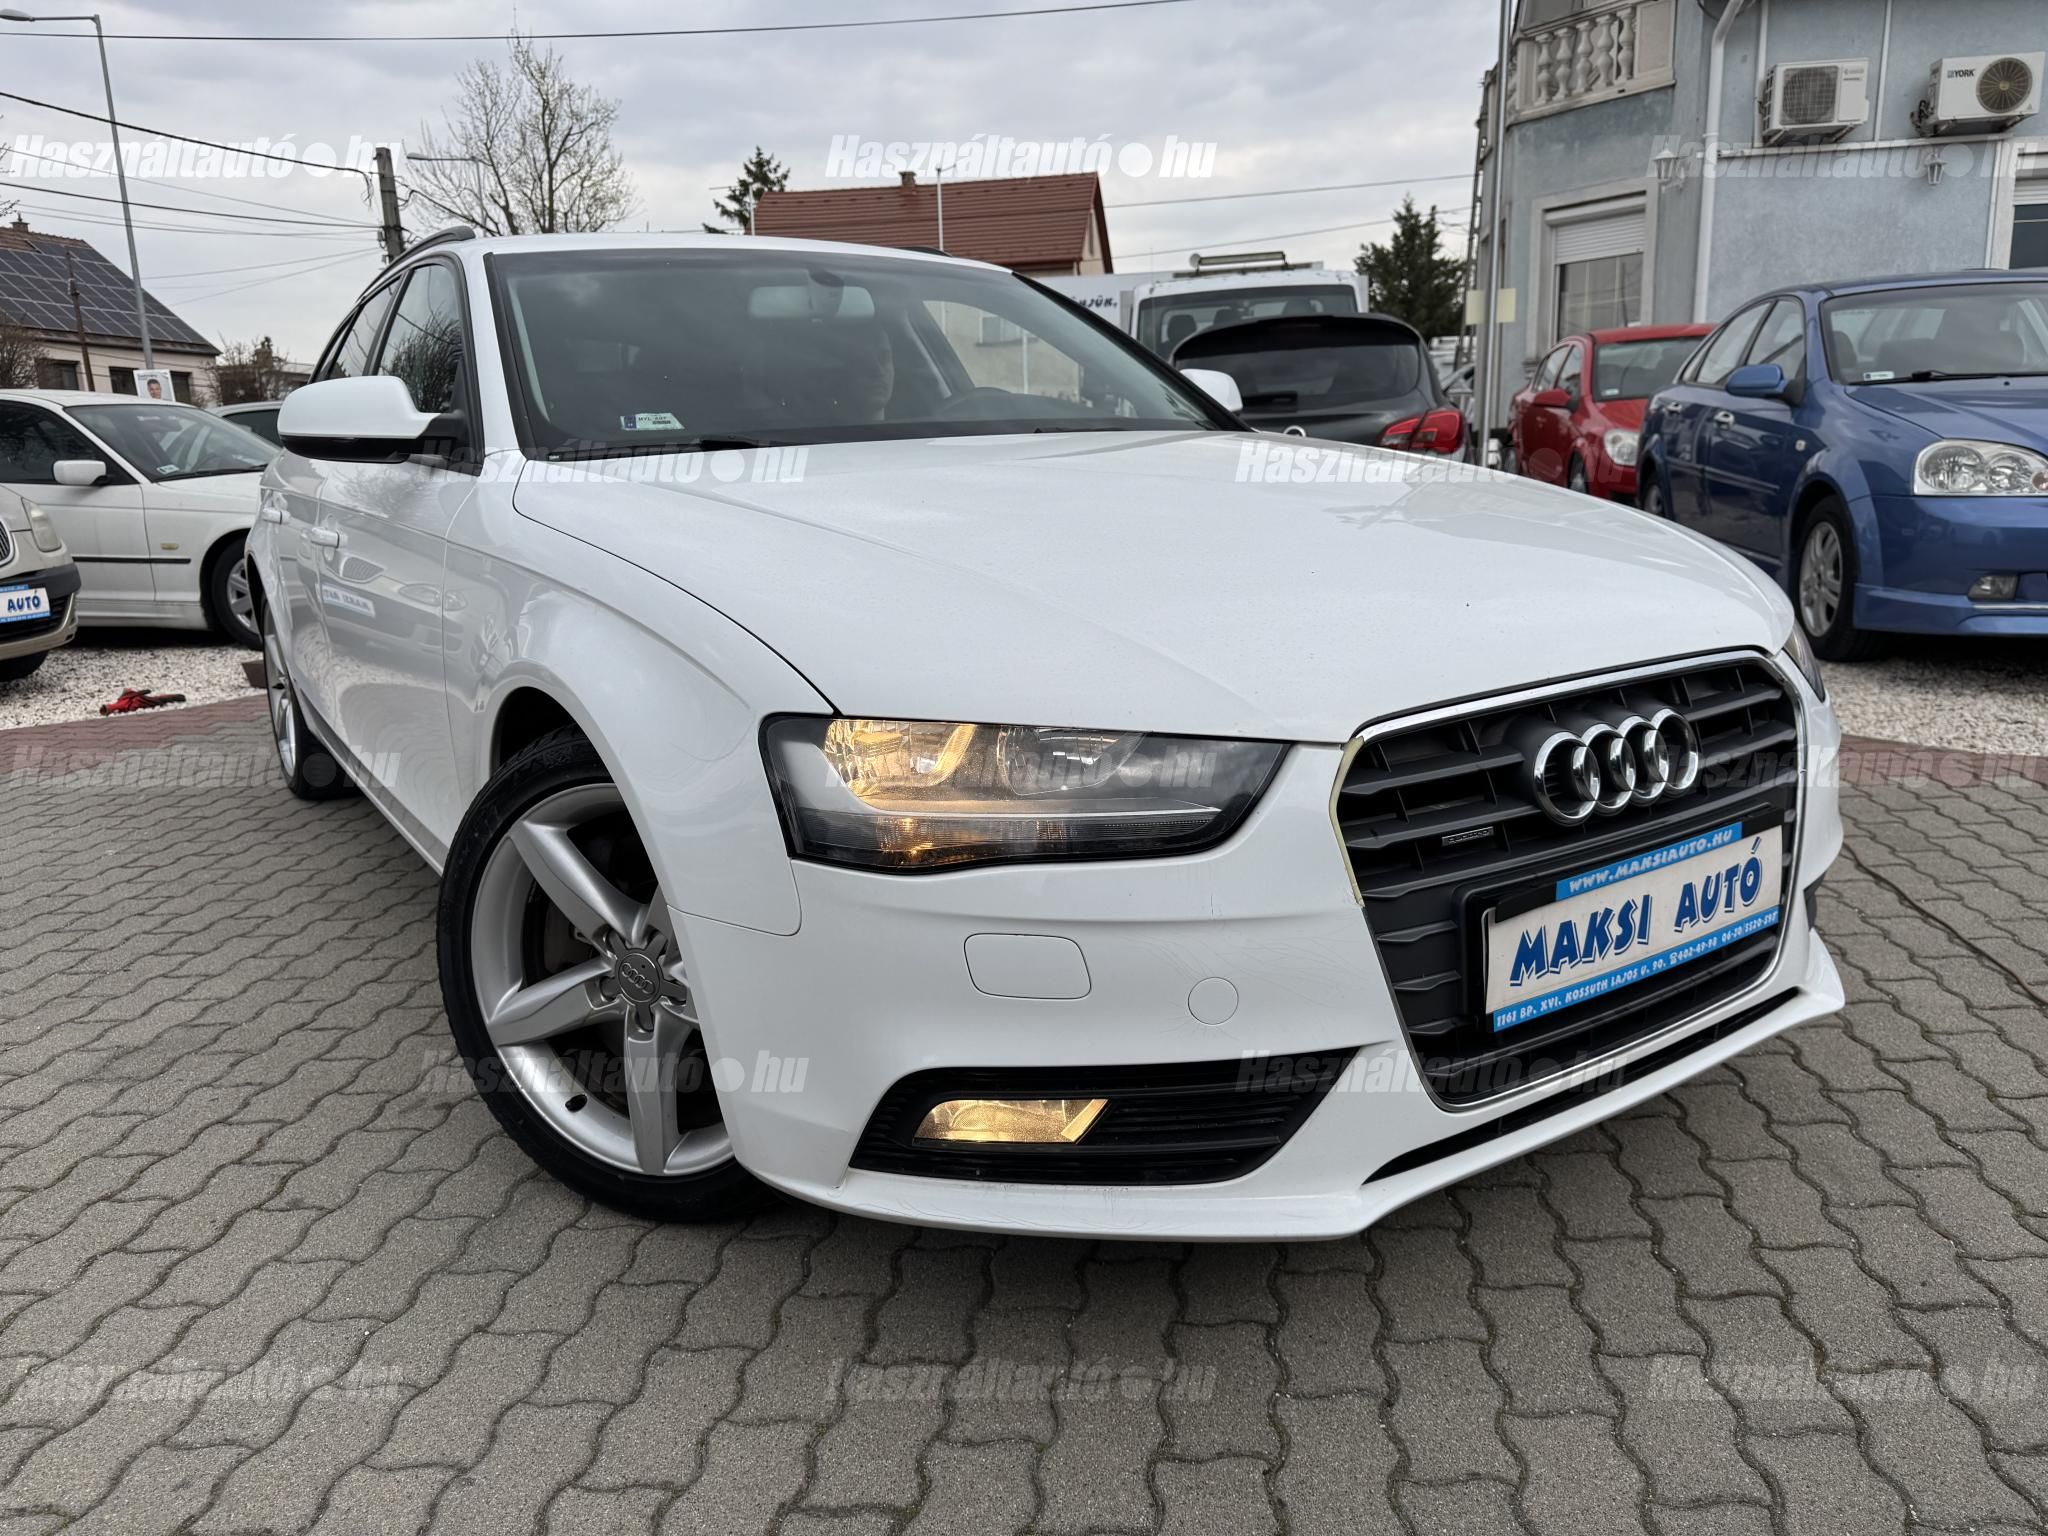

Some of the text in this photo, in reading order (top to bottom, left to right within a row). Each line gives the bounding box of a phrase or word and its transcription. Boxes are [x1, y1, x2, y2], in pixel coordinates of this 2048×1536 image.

[1954, 69, 1976, 78] YORK
[7, 589, 41, 612] AUTÓ
[1569, 829, 1733, 893] WWW.MAKSIAUTO.HU
[1509, 836, 1763, 986] MAKSI AUTÓ
[1497, 1010, 1517, 1028] 1161
[1520, 1004, 1537, 1019] BP.
[1540, 996, 1562, 1012] XVI.
[1565, 979, 1608, 1004] KOSSUTH
[1611, 968, 1638, 987] LAJOS
